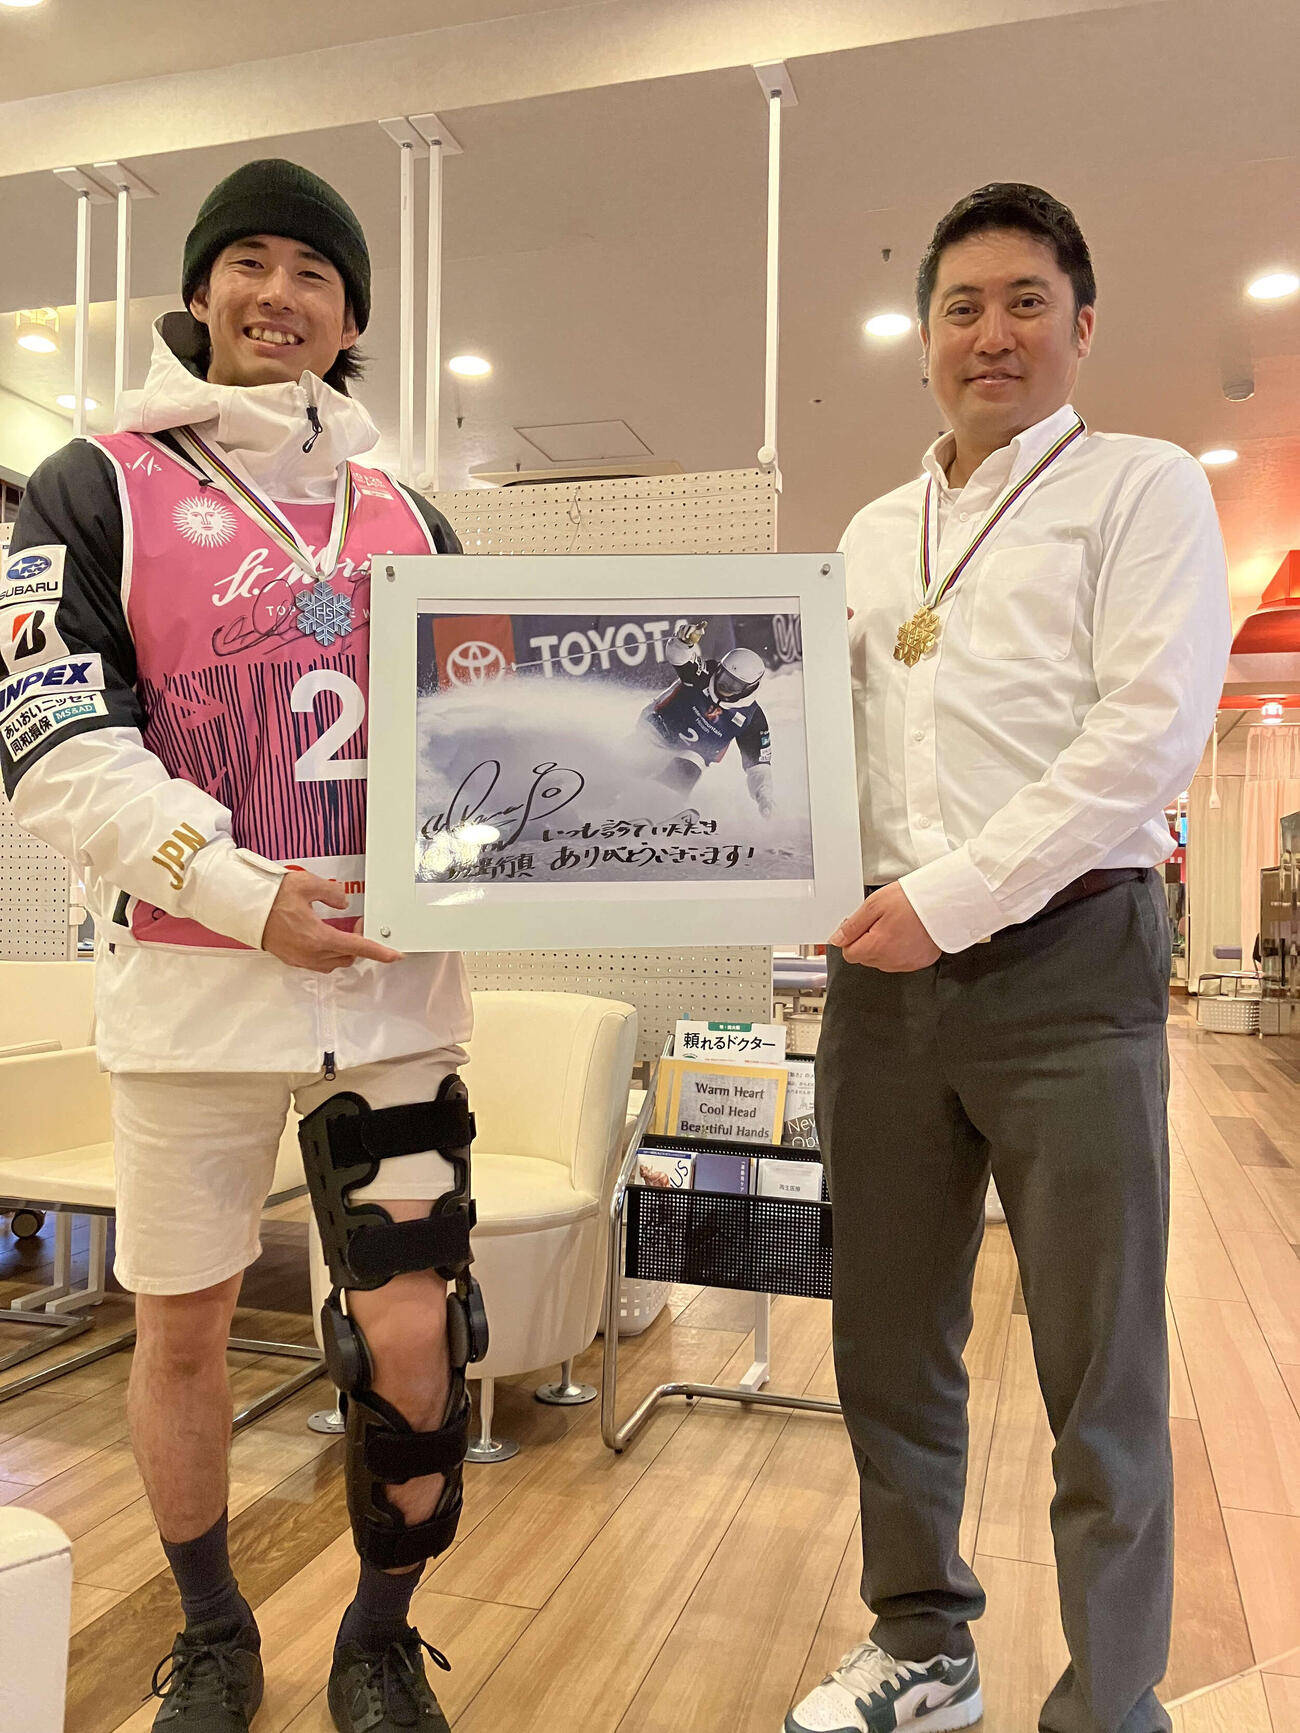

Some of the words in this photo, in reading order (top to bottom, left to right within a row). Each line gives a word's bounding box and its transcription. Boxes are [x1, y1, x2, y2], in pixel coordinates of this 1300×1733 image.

[0, 581, 58, 600] SUBARU
[4, 693, 97, 739] あいおいニッセイ
[56, 704, 93, 720] MS&AD
[291, 669, 366, 781] 2
[10, 715, 53, 757] 同和損保
[152, 822, 206, 890] JPN
[683, 1032, 776, 1051] 頼れるドクター
[695, 1082, 730, 1097] Warm
[734, 1086, 764, 1099] Heart
[699, 1103, 724, 1115] Cool
[728, 1106, 757, 1118] Head
[736, 1126, 769, 1138] Hands
